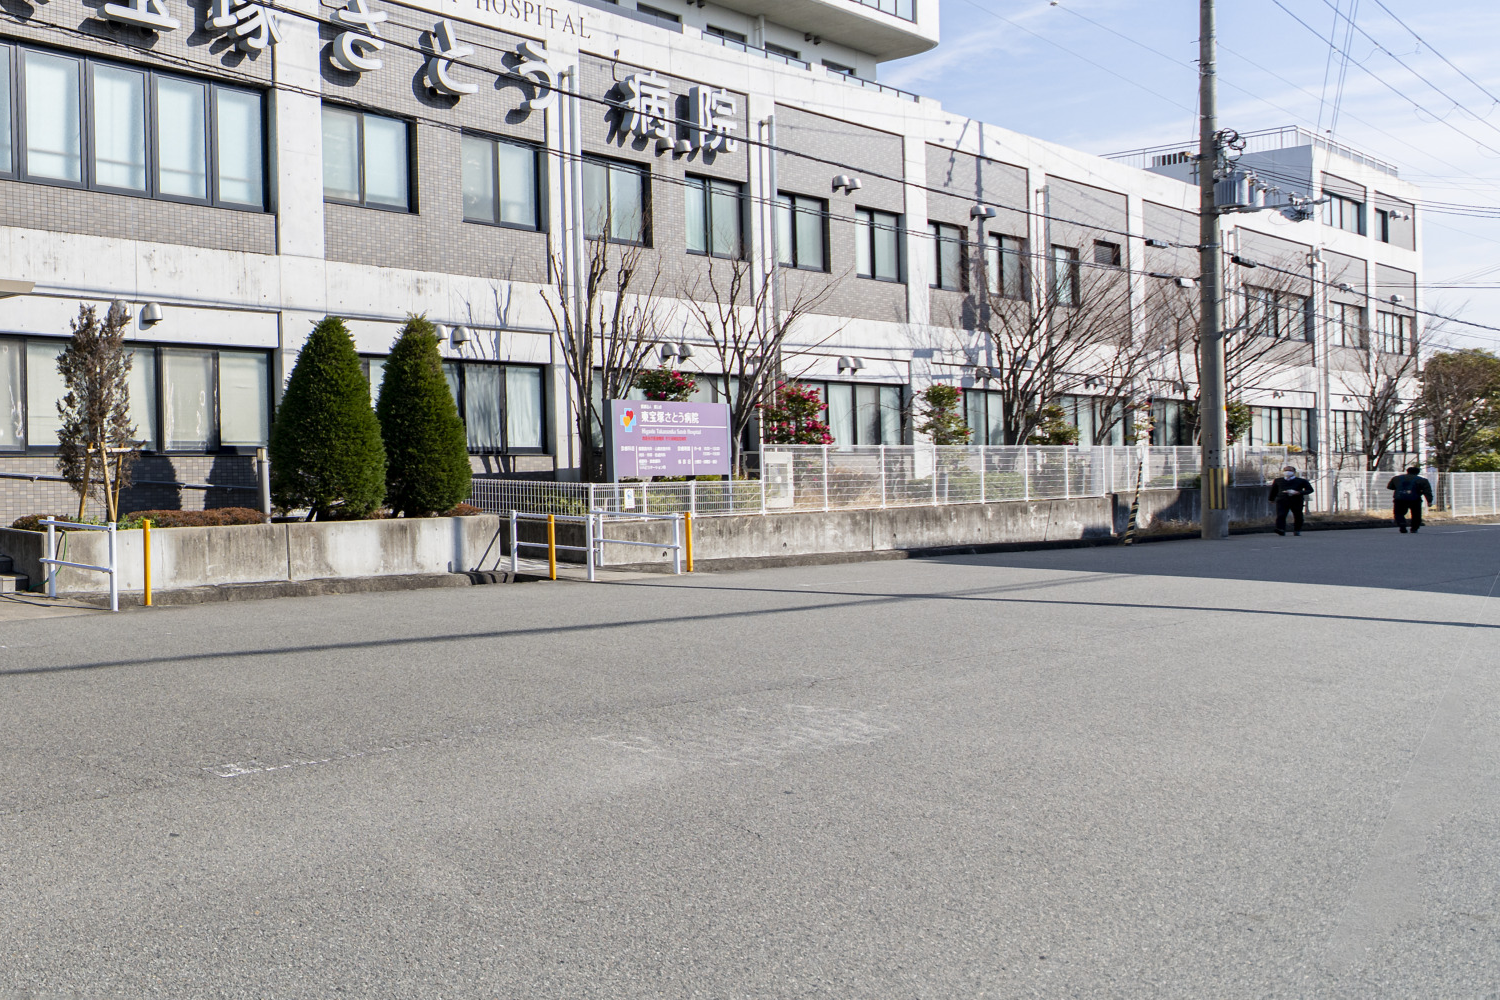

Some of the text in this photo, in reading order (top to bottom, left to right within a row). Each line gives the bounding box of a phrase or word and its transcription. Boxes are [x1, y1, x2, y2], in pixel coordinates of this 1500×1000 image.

[641, 411, 699, 424] 東宝塚さとう病院
